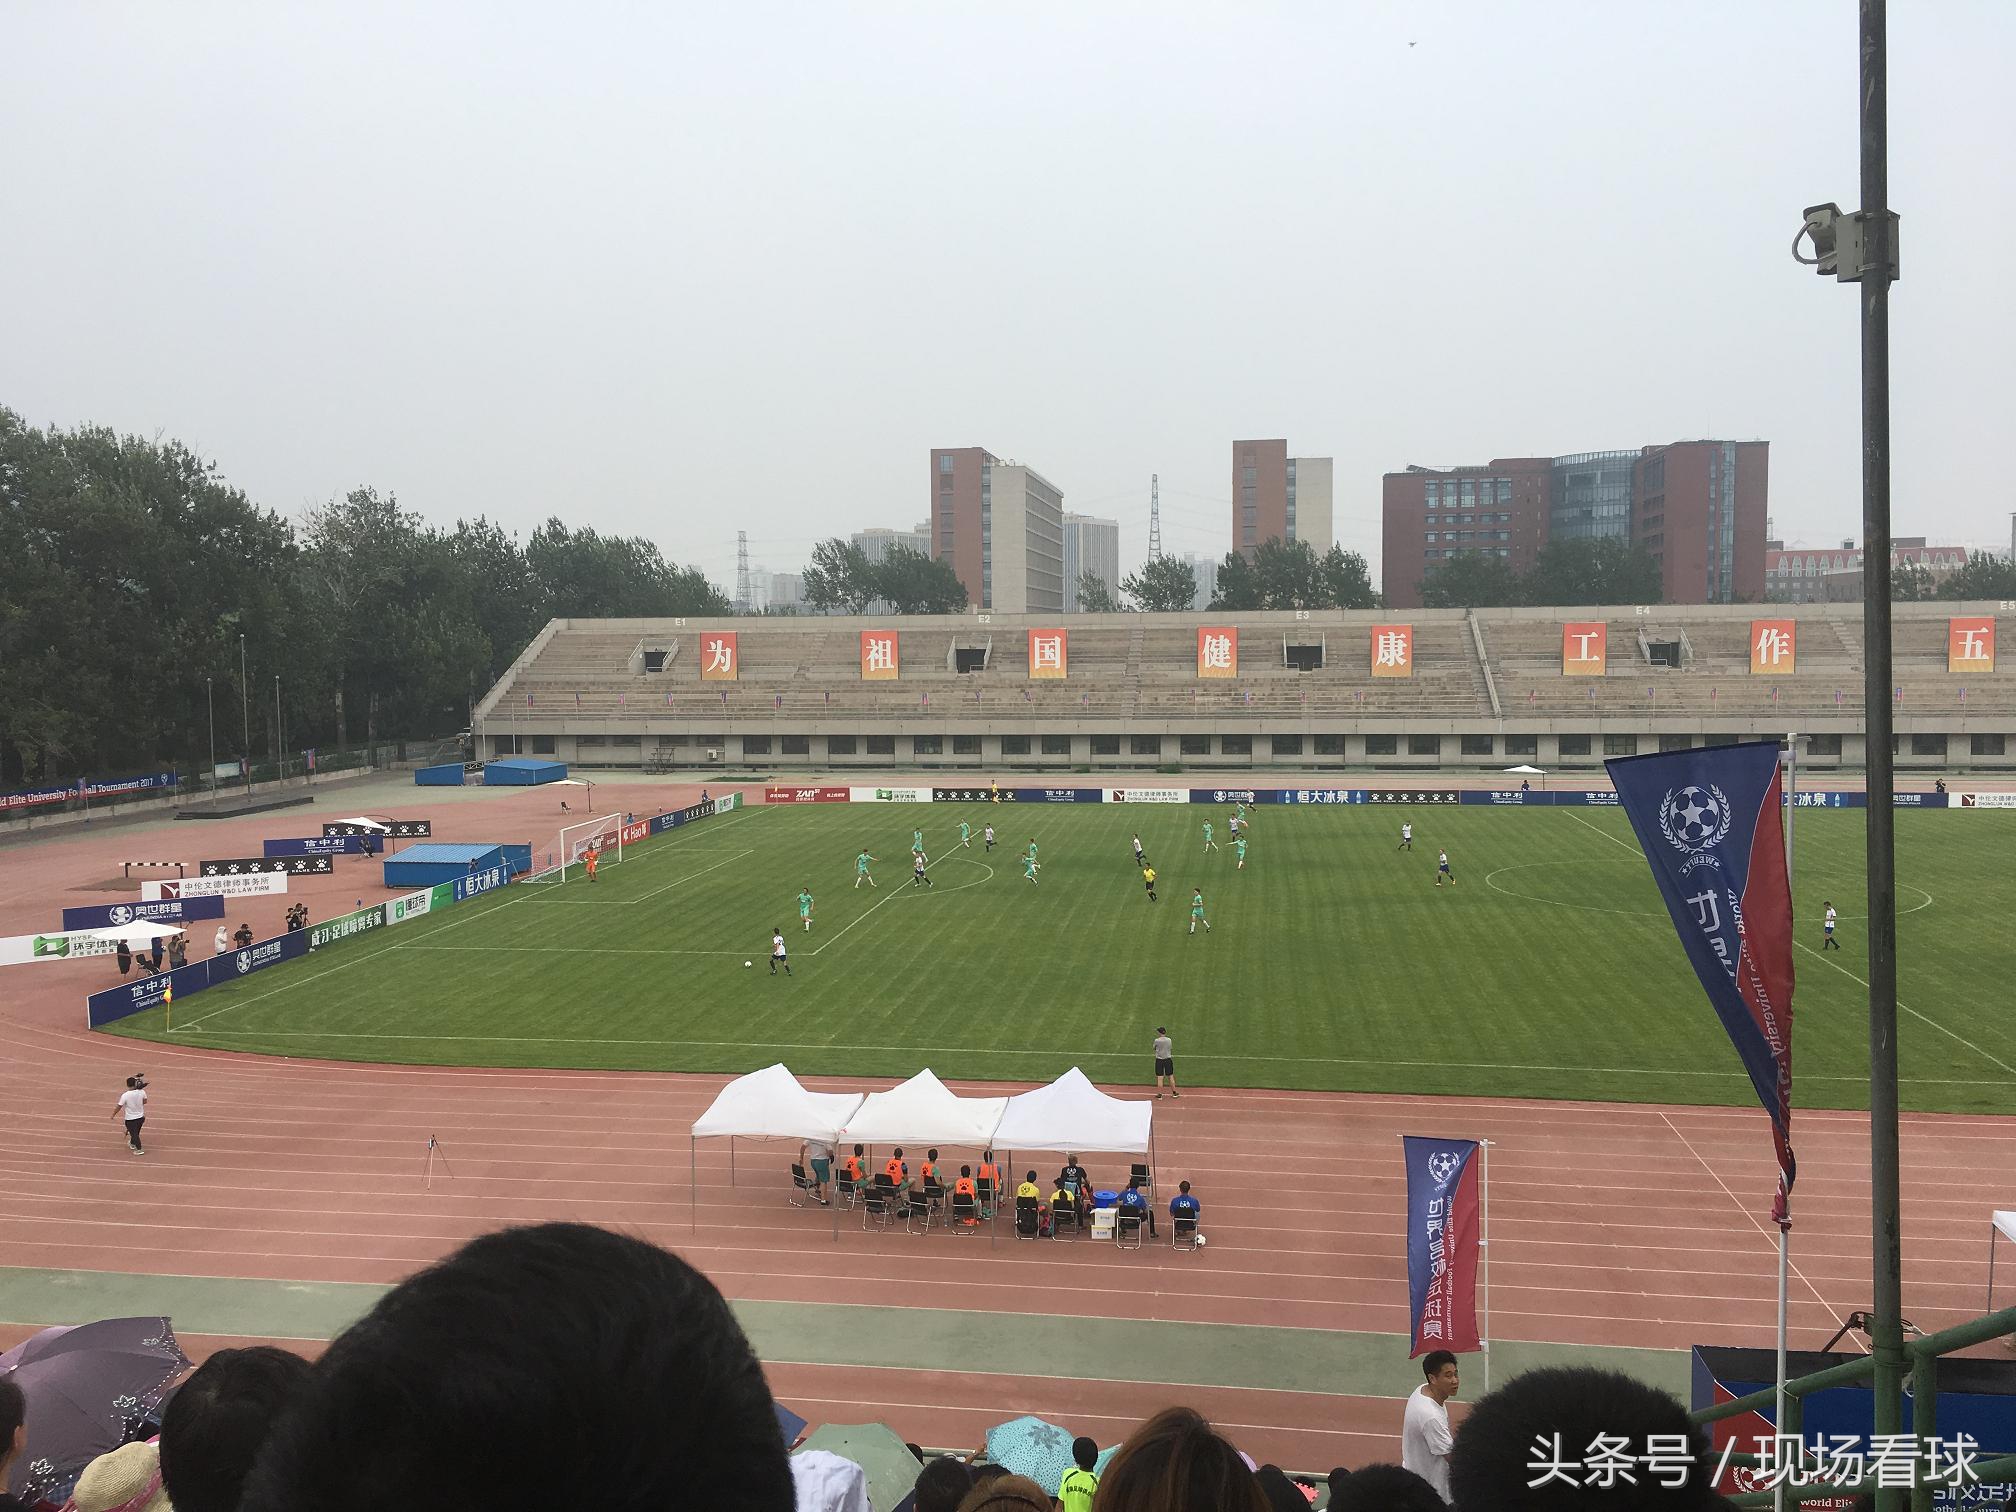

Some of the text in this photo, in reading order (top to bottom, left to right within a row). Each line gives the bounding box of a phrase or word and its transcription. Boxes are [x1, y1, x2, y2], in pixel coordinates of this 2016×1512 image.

[1636, 607, 1651, 616] E4
[2000, 602, 2015, 612] E5
[979, 615, 991, 624] E2
[1295, 611, 1310, 620] E3
[675, 618, 686, 626] E1
[707, 626, 1989, 673] 为 祖 国 健 康 工 作 五
[9, 792, 26, 805] Elite
[28, 788, 67, 803] University
[98, 779, 140, 792] Tournament
[1297, 790, 1349, 804] 恒大冰泉
[304, 838, 345, 848] 信中利
[185, 876, 270, 890] 中伦文德律师事务所
[466, 868, 500, 896] 恒大冰泉
[131, 975, 171, 998] 信中利
